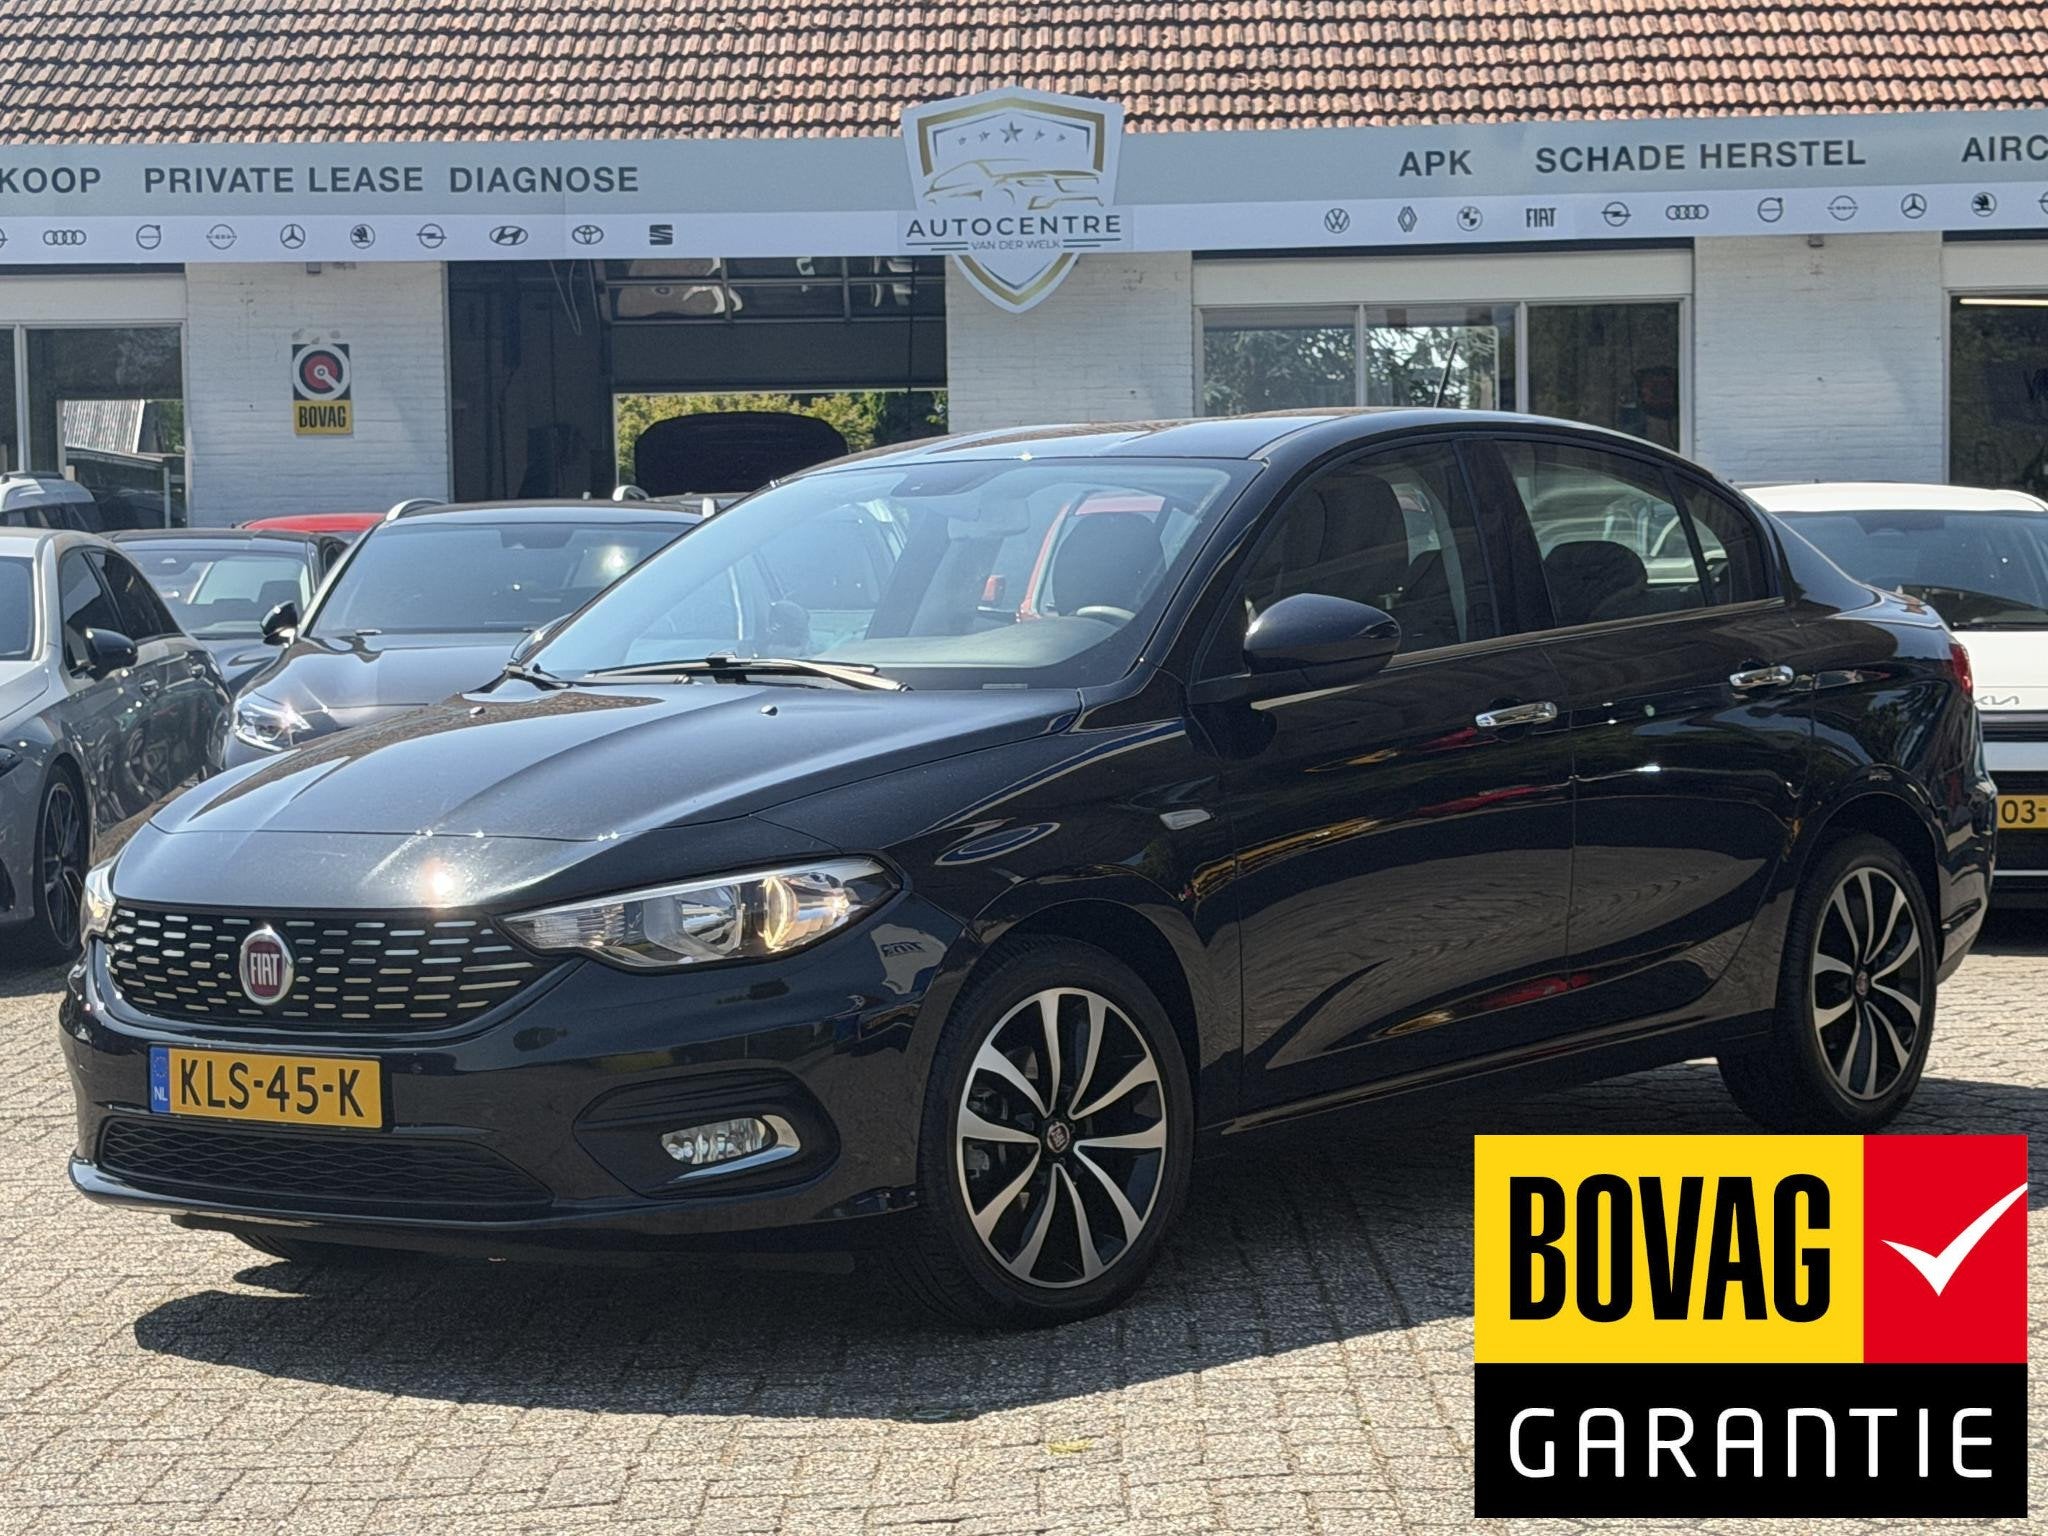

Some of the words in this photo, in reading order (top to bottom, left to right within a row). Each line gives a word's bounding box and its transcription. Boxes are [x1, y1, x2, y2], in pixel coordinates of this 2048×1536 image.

[1536, 144, 1685, 174] SCHADE
[1700, 140, 1866, 169] HERSTEL
[1961, 134, 2048, 163] AIRC
[1399, 150, 1472, 177] APK
[0, 167, 101, 194] KOOP
[144, 167, 294, 193] PRIVATE
[309, 166, 423, 193] LEASE
[450, 166, 638, 193] DIAGNOSE
[906, 215, 1121, 238] AUTOCENTRE
[1525, 207, 1557, 228] FIAT
[971, 241, 996, 251] VAN
[999, 239, 1023, 250] DER
[1027, 238, 1060, 249] WELK
[298, 405, 347, 428] BOVAG
[250, 952, 280, 986] FIAT
[153, 1086, 168, 1102] NL
[180, 1058, 365, 1118] KLS-45-K
